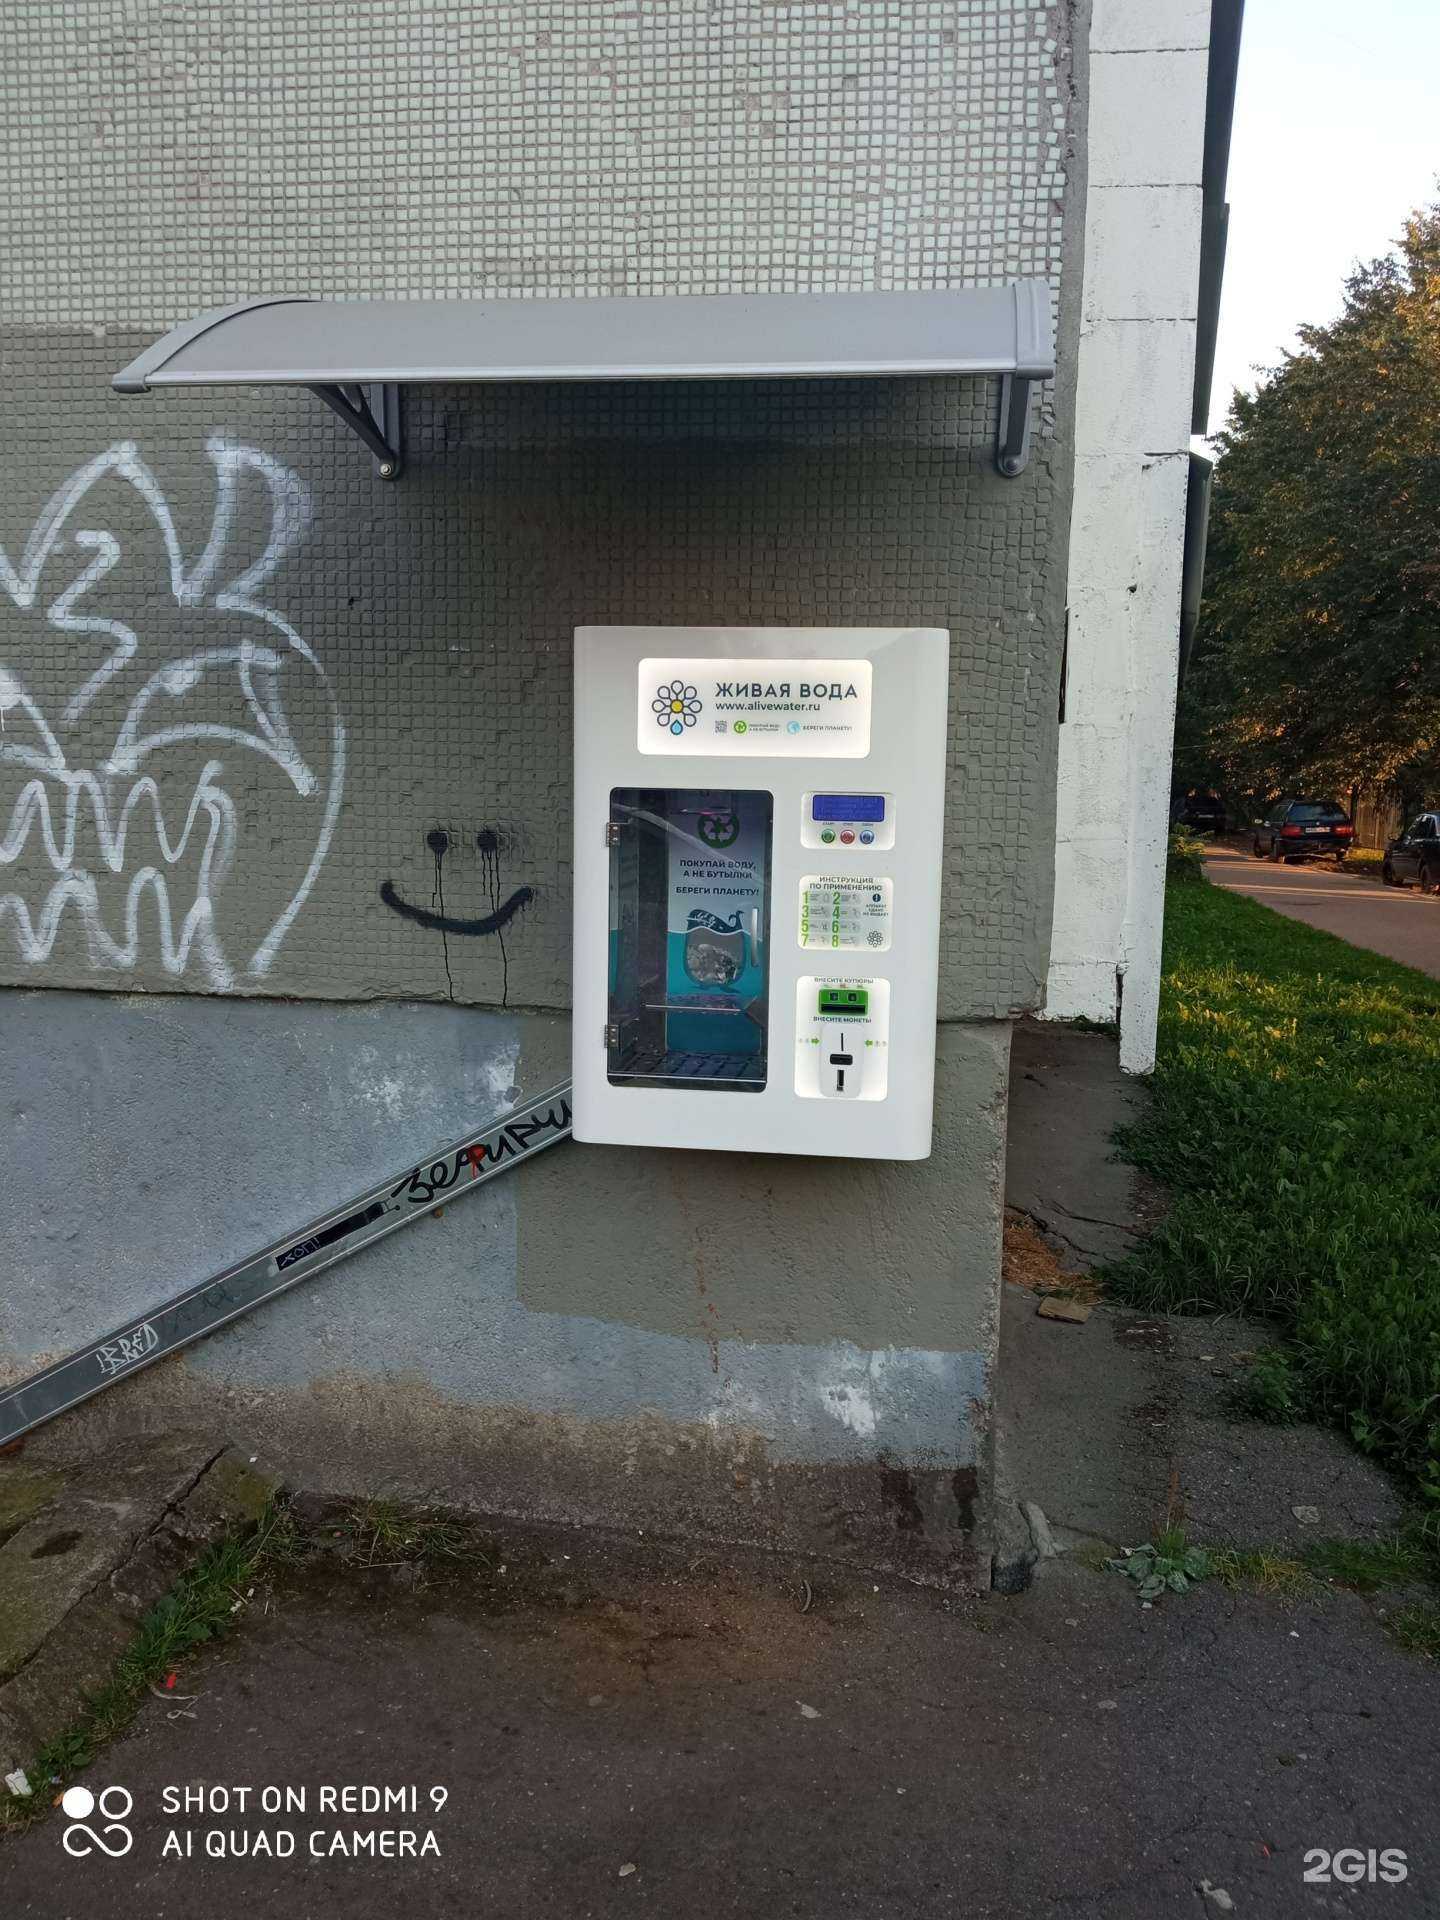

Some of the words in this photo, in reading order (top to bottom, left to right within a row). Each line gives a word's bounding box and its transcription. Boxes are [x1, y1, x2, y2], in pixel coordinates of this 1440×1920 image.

[715, 682, 791, 699] ЖИВАЯ
[799, 683, 858, 701] ВОДА
[715, 701, 821, 712] www.alivewater.ru
[680, 859, 725, 868] ПОКУПАЙ
[727, 860, 756, 870] ВОДУ,
[683, 870, 690, 878] А
[692, 870, 705, 878] НЕ
[706, 870, 753, 879] БУТЫЛКИ
[819, 876, 874, 884] ИНСТРУКЦИЯ
[675, 886, 711, 894] БЕРЕГИ
[712, 887, 760, 896] ПЛАНЕТУ!
[802, 890, 809, 904] 1
[832, 891, 841, 905] 2
[801, 905, 809, 918] 3
[832, 906, 840, 919] 4
[801, 919, 809, 933] 5
[832, 920, 840, 934] 6
[801, 934, 809, 947] 7
[831, 934, 839, 948] 8
